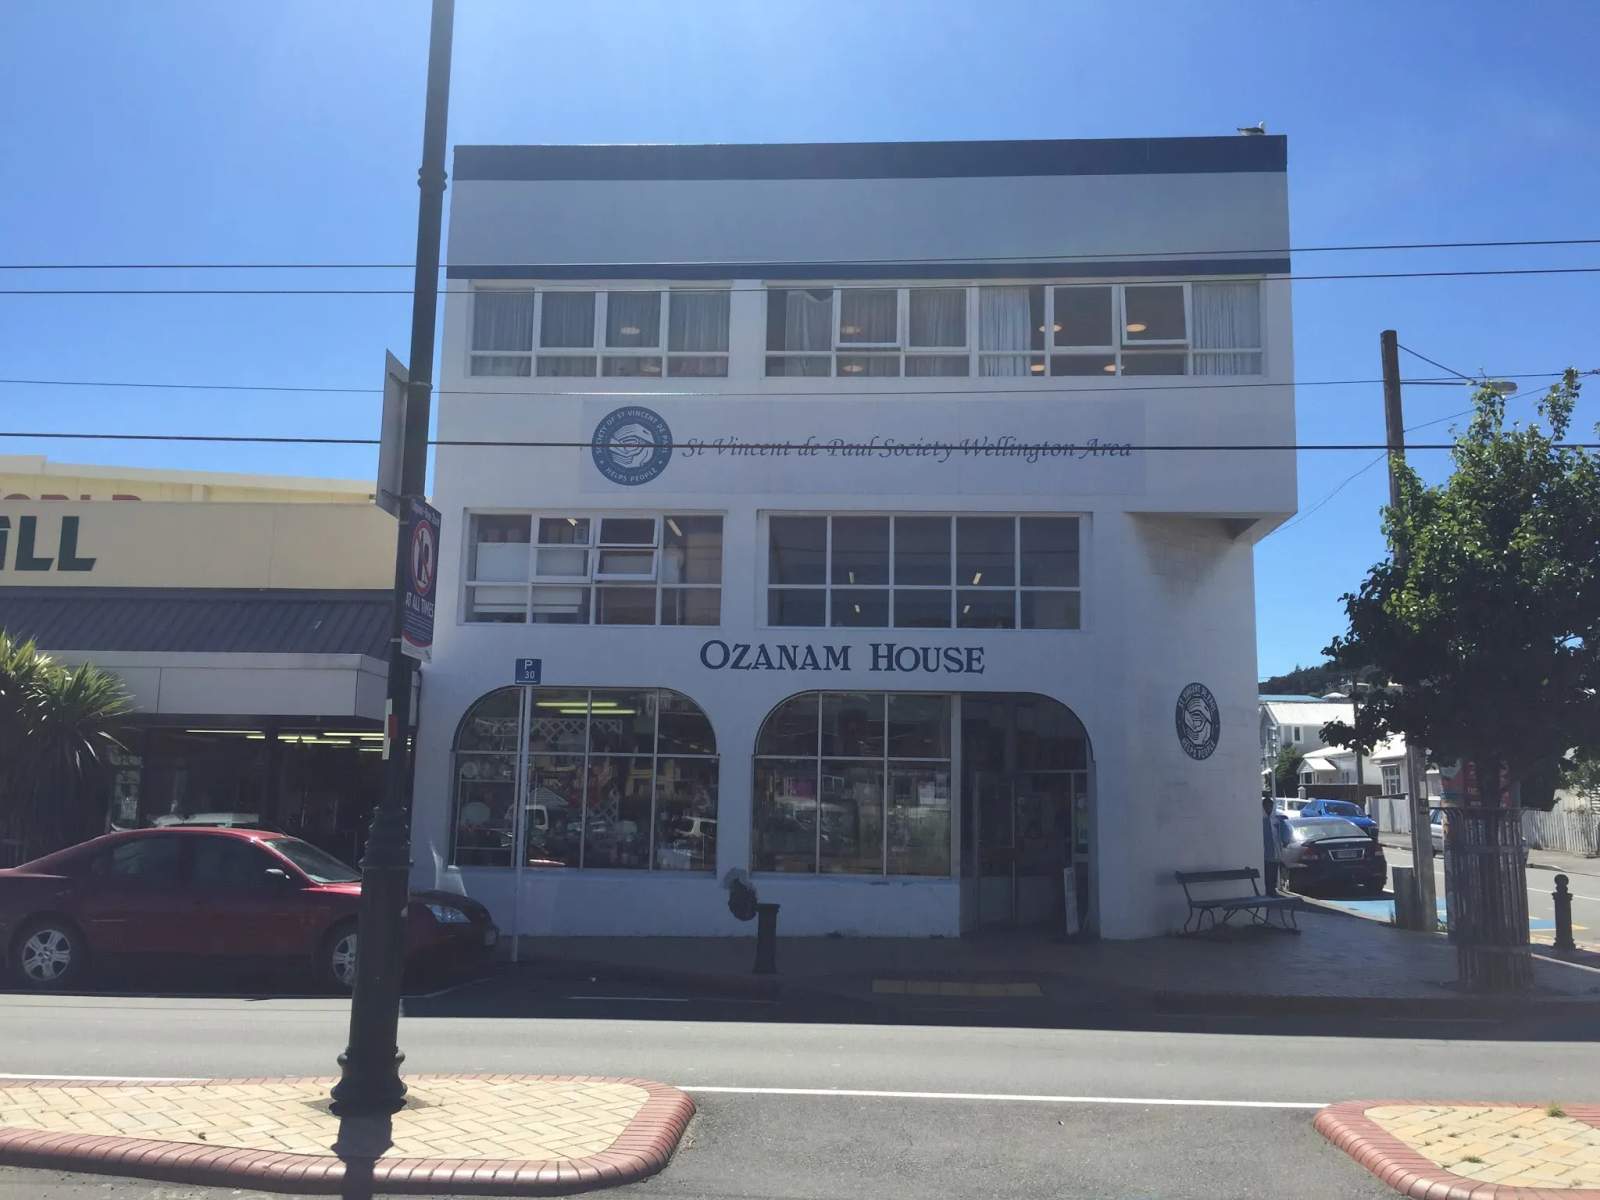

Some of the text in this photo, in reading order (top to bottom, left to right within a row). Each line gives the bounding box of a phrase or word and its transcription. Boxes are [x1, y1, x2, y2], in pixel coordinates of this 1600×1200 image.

[606, 416, 616, 425] OF
[627, 410, 658, 423] VINCENT
[682, 436, 1132, 463] St Vincent de Paul Society Wellington Area
[630, 467, 657, 482] PEOPLE
[700, 640, 985, 674] OZANAM HOUSE
[524, 660, 533, 670] P
[524, 671, 535, 679] 30
